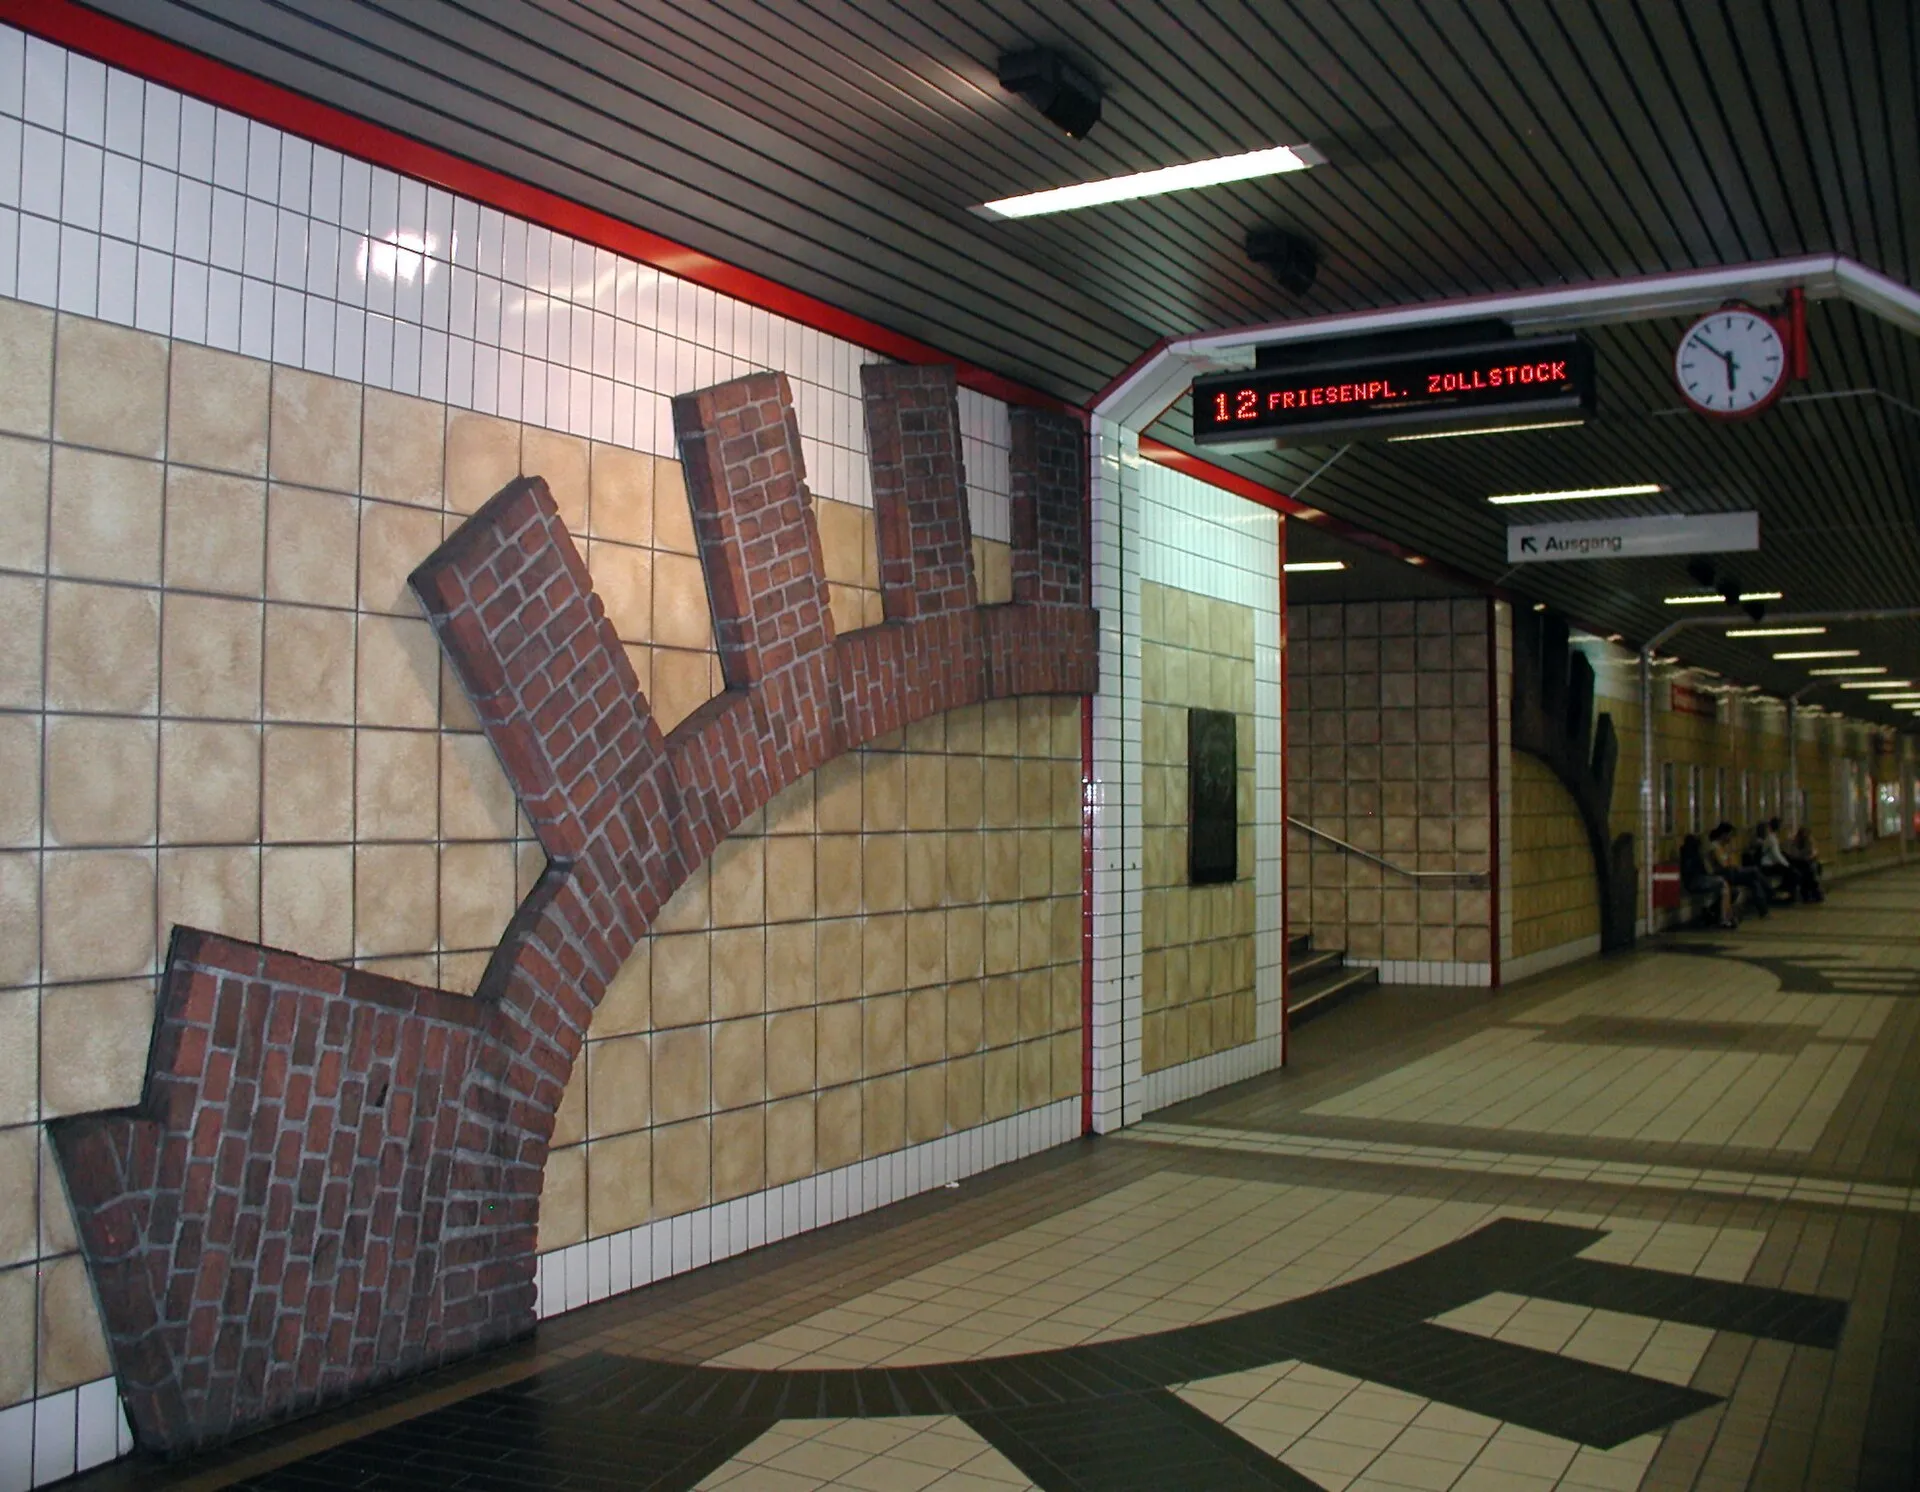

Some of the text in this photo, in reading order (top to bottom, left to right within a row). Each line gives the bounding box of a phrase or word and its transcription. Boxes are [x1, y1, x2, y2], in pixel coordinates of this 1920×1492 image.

[1216, 360, 1567, 421] 12 FRIESENPL. ZOLLSTOCK
[1545, 535, 1623, 553] Ausgang
